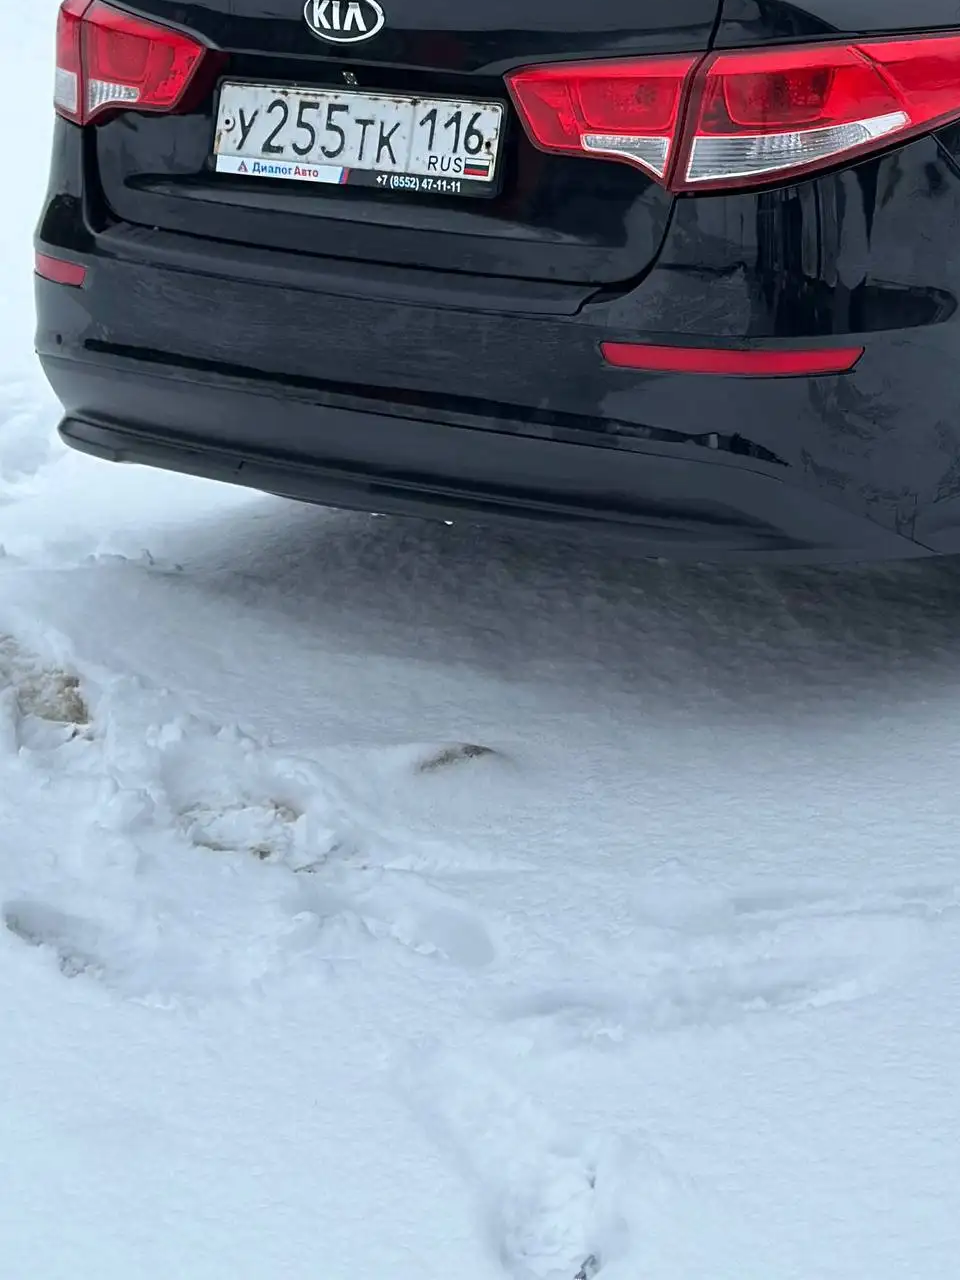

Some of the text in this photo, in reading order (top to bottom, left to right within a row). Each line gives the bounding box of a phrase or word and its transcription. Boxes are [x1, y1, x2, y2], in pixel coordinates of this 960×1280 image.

[419, 108, 485, 156] 116
[427, 155, 463, 174] RUS
[389, 175, 420, 191] (8552)
[421, 177, 462, 193] 47-11-11
